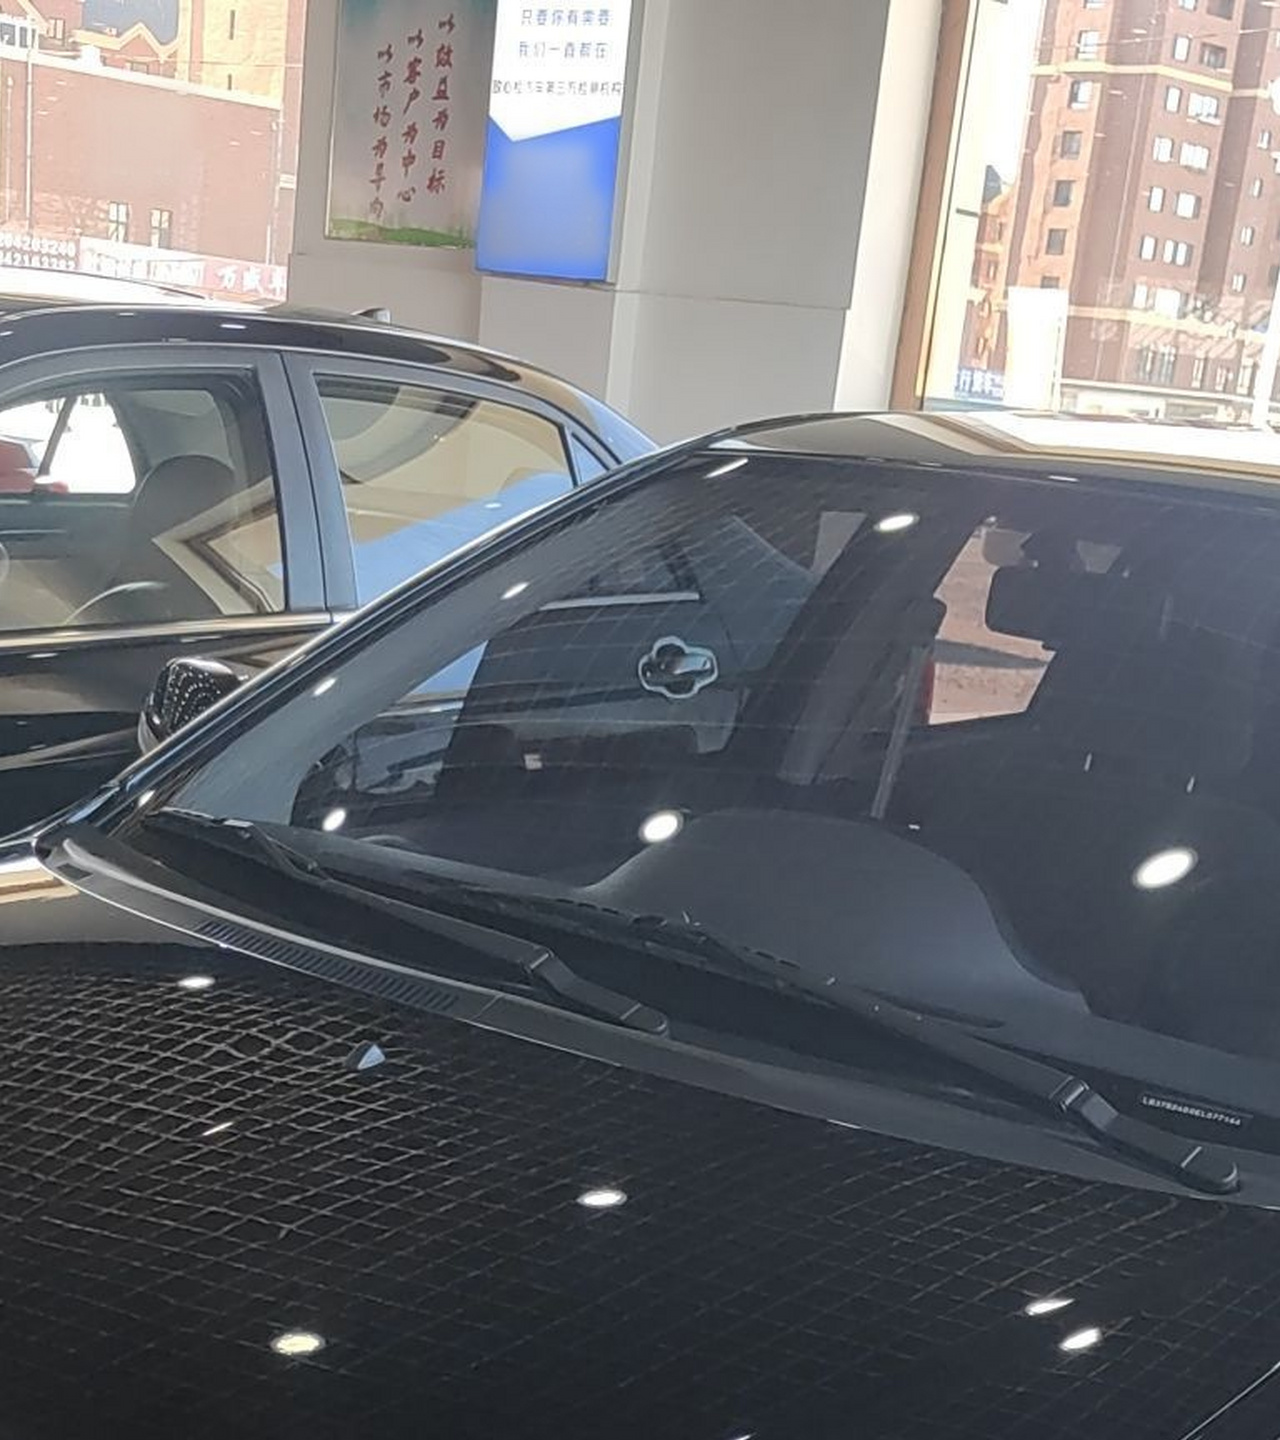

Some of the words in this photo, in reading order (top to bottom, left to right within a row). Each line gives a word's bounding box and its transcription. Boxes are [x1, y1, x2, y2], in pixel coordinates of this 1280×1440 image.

[369, 43, 394, 219] 以市场为导向
[397, 28, 424, 202] 以客户为中心
[426, 13, 456, 195] 以效益为目标
